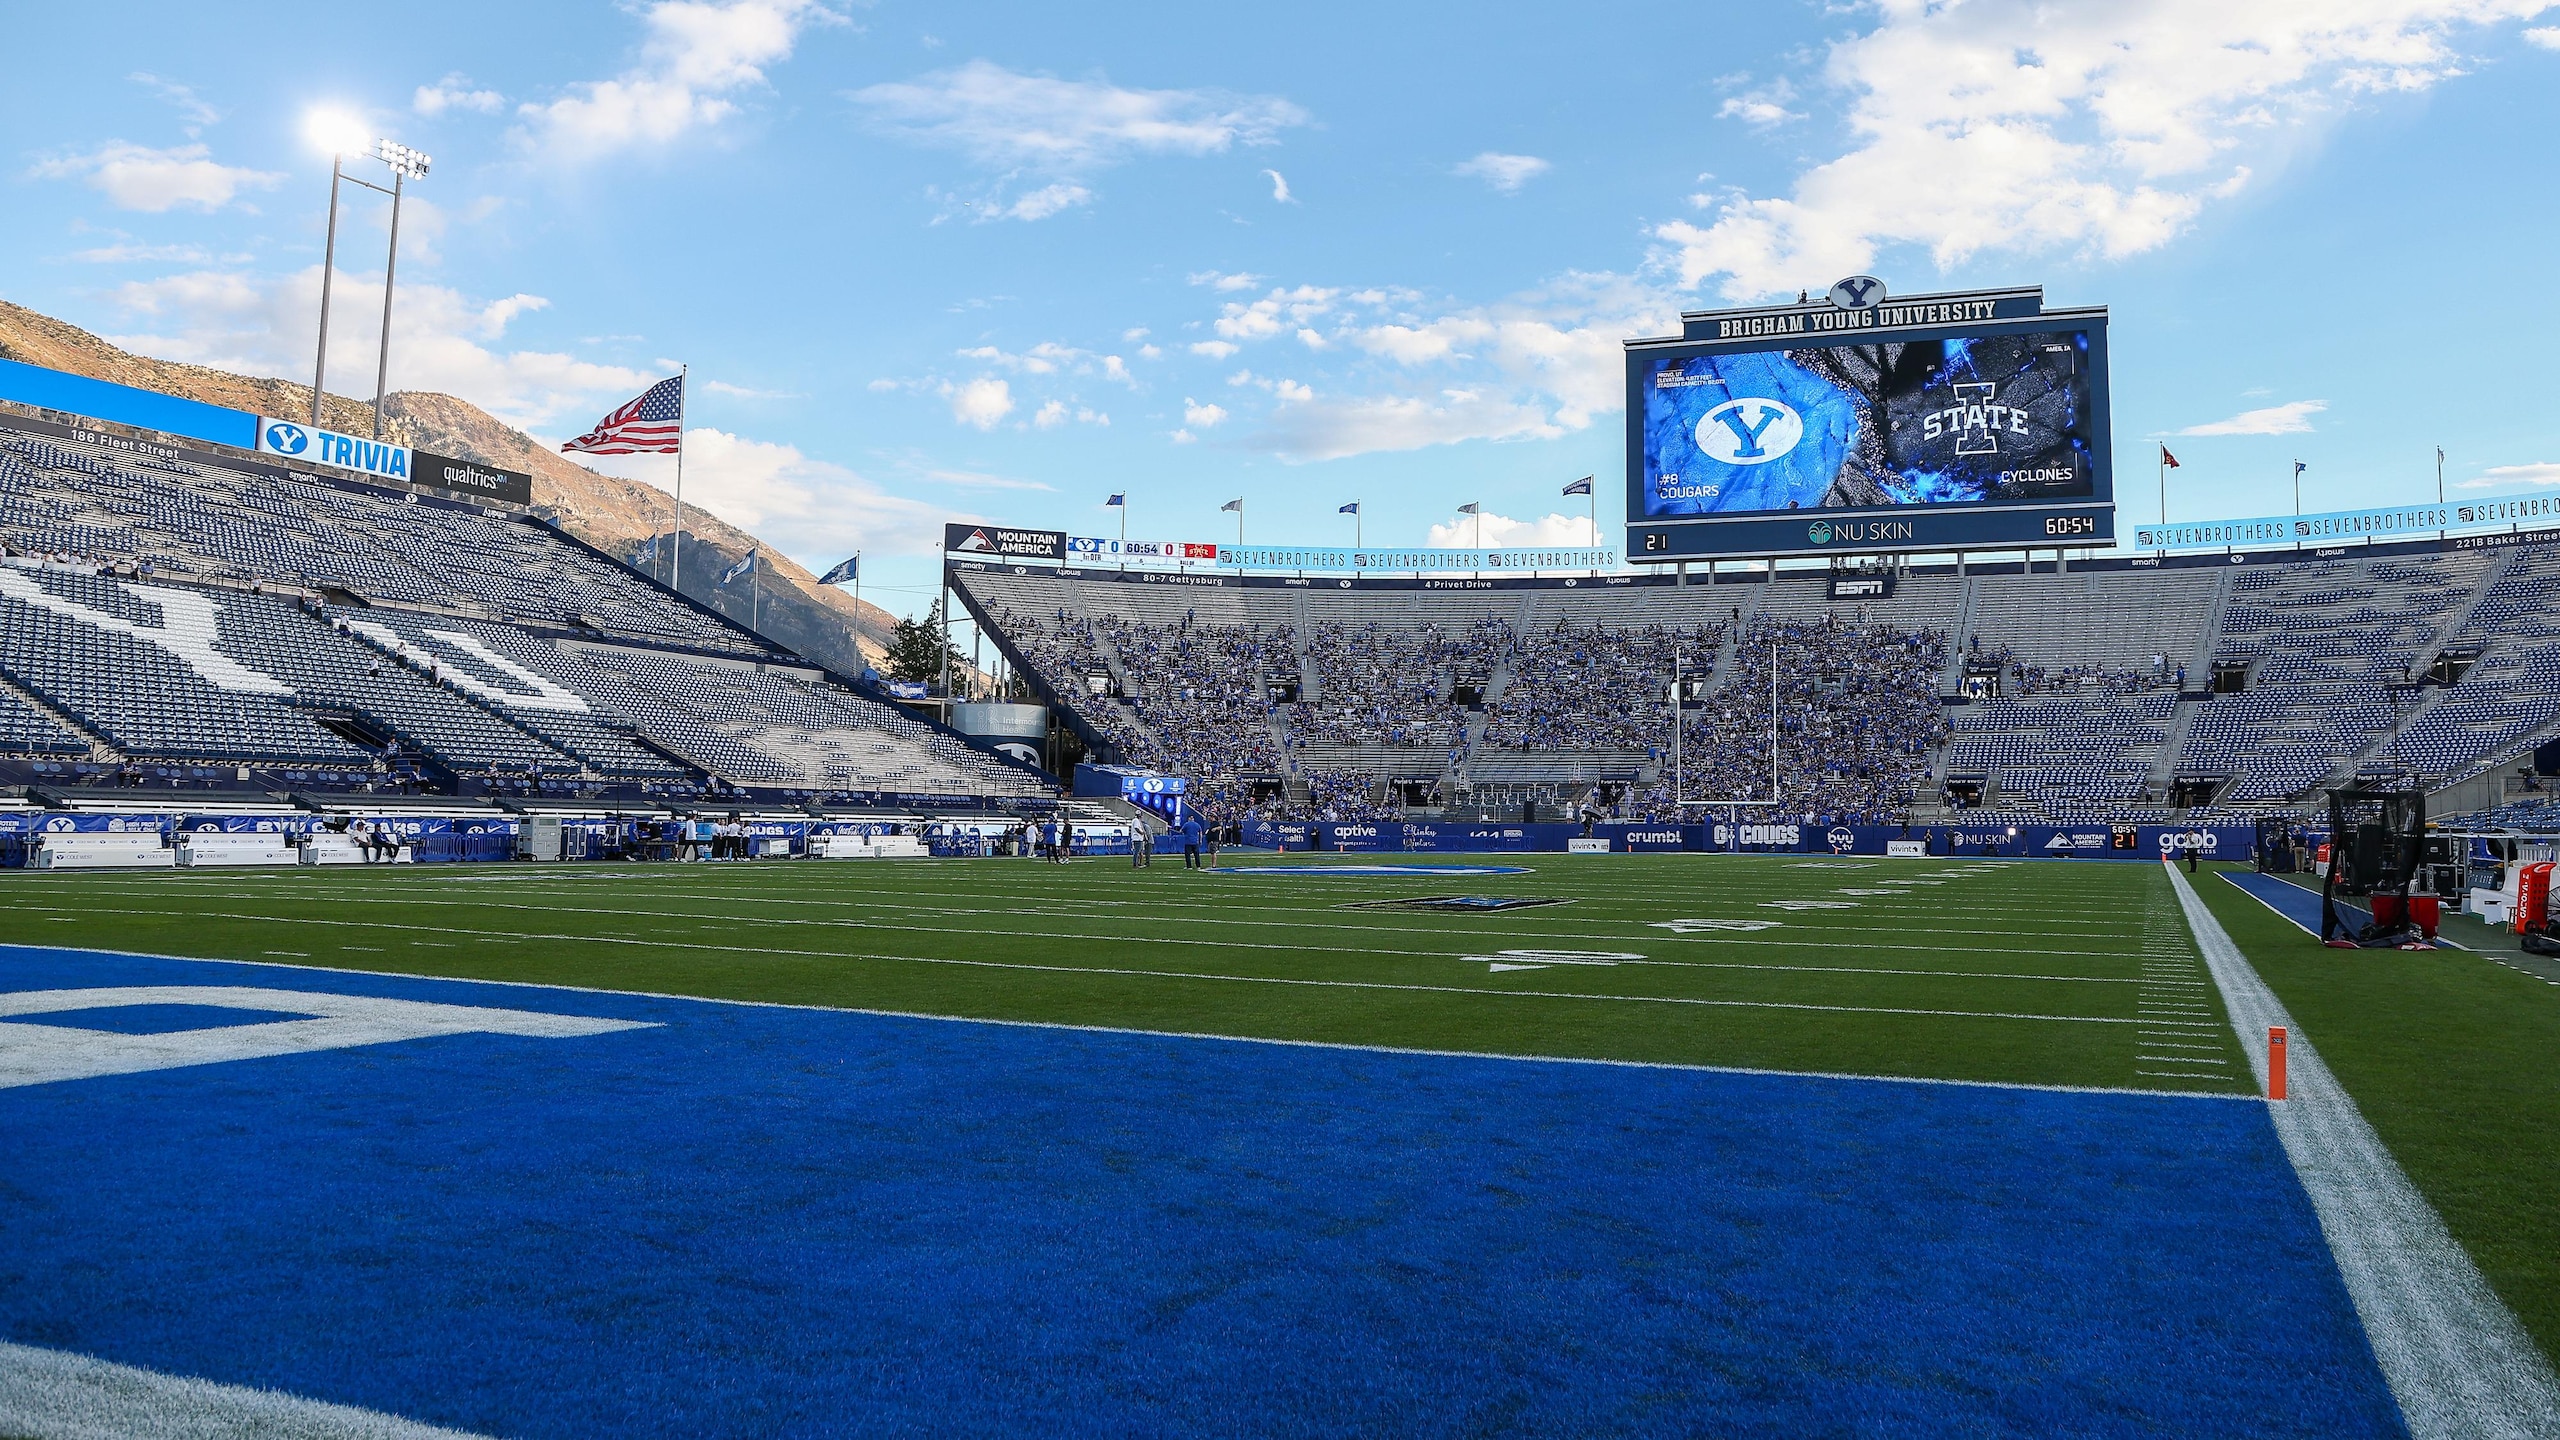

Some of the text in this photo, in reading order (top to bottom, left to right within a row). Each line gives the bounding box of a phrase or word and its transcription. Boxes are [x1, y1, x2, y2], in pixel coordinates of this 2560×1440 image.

[1838, 279, 1877, 306] Y
[1720, 300, 1996, 338] BRIGHAM YOUNG UNIVERSITY
[1923, 404, 2029, 441] STATE
[1713, 405, 1784, 457] Y
[71, 429, 179, 460] 186 Fleet Street
[318, 432, 407, 478] TRIVIA
[443, 465, 497, 490] qualtrics
[1659, 474, 1679, 485] #8
[2001, 467, 2073, 483] CYCLONES
[1660, 485, 1719, 499] COUGARS
[2046, 517, 2094, 535] 60:54
[2314, 509, 2447, 536] SEVENBROTHERS
[997, 531, 1057, 545] MOUNTAIN
[1835, 522, 1912, 541] NU SKIN
[2156, 523, 2283, 545] SEVENBROTHERS
[1000, 542, 1053, 555] AMERICA
[1111, 541, 1119, 552] 0
[1127, 543, 1158, 554] 60:54
[1166, 544, 1174, 555] 0
[2456, 538, 2484, 548] 221B
[2487, 535, 2521, 546] Baker
[1236, 551, 1345, 567] SEVENBROTHERS
[1370, 554, 1479, 567] SEVENBROTHERS
[1505, 552, 1613, 567] SEVENBROTHERS
[1143, 574, 1223, 586] 80-7 Gettysburg
[1434, 580, 1463, 588] Privet
[1466, 580, 1492, 588] Drive
[1835, 580, 1883, 595] ESPN
[1002, 725, 1027, 735] Health
[1279, 824, 1305, 834] Select
[1334, 824, 1377, 840] aptive
[1627, 830, 1682, 843] crumbl
[1739, 824, 1799, 845] COUGS
[2112, 825, 2137, 833] 60:54
[1966, 835, 2010, 844] NU SKIN
